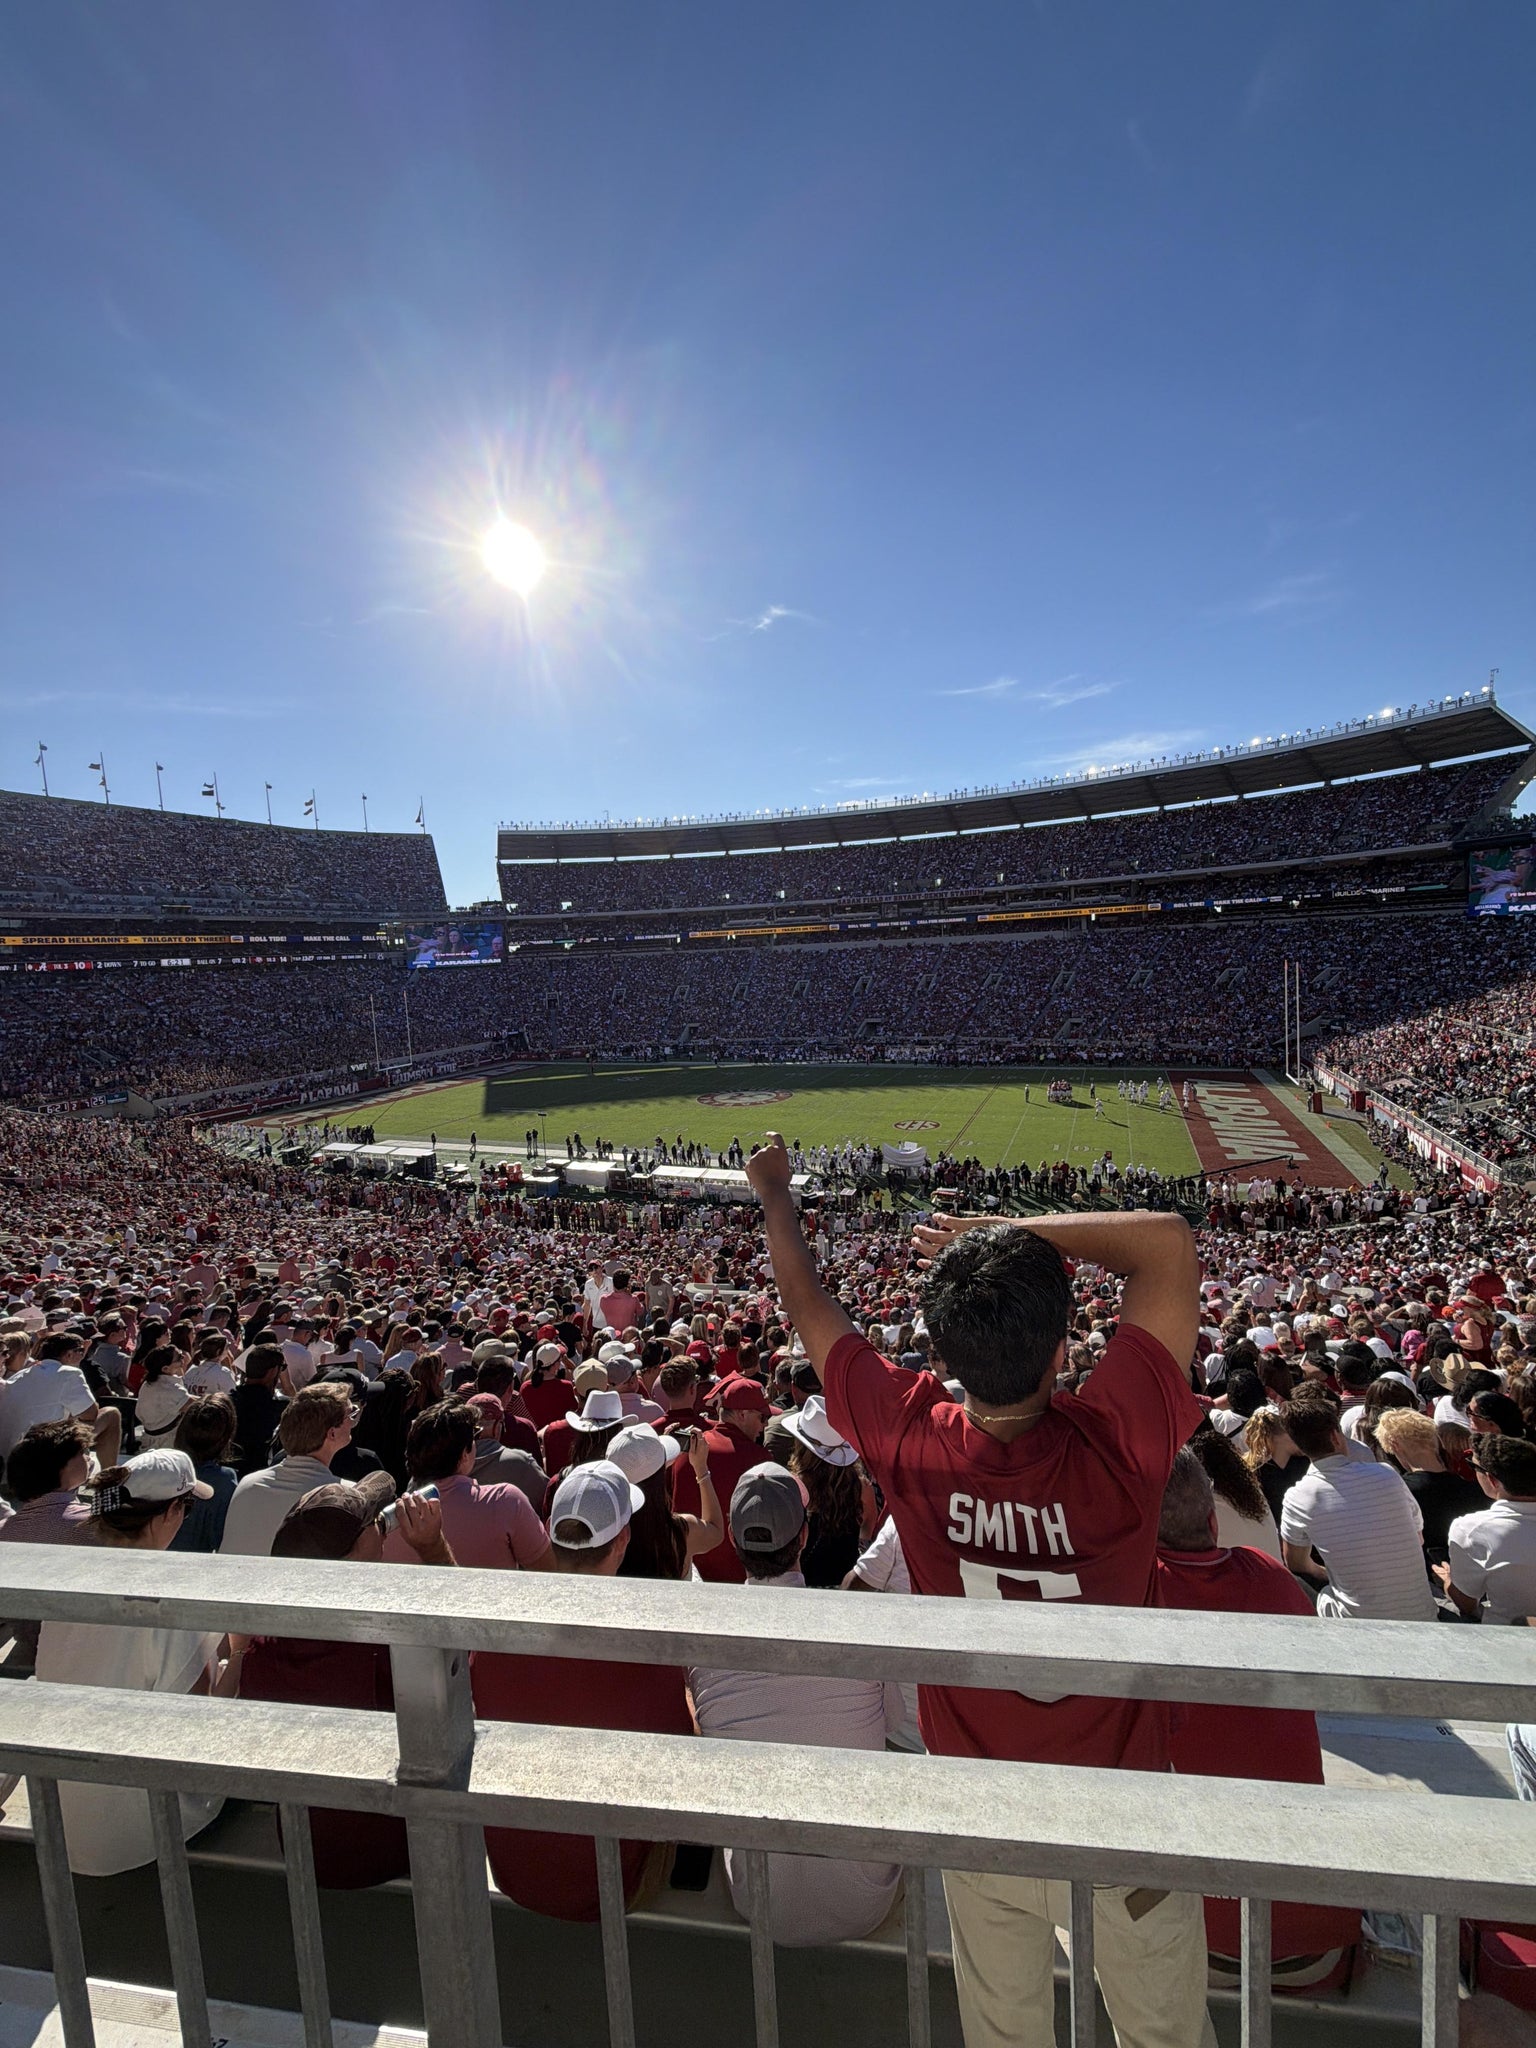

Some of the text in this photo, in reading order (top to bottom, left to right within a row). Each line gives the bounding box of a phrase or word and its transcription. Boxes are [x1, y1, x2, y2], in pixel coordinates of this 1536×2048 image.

[22, 937, 66, 945] SPREAD
[67, 936, 129, 944] HELLMANN'S
[74, 961, 86, 970] 10
[97, 961, 104, 969] 2
[133, 960, 139, 968] 7
[300, 1082, 360, 1105] ALABAMA
[93, 1097, 104, 1105] 25
[947, 1492, 1075, 1556] SMITH
